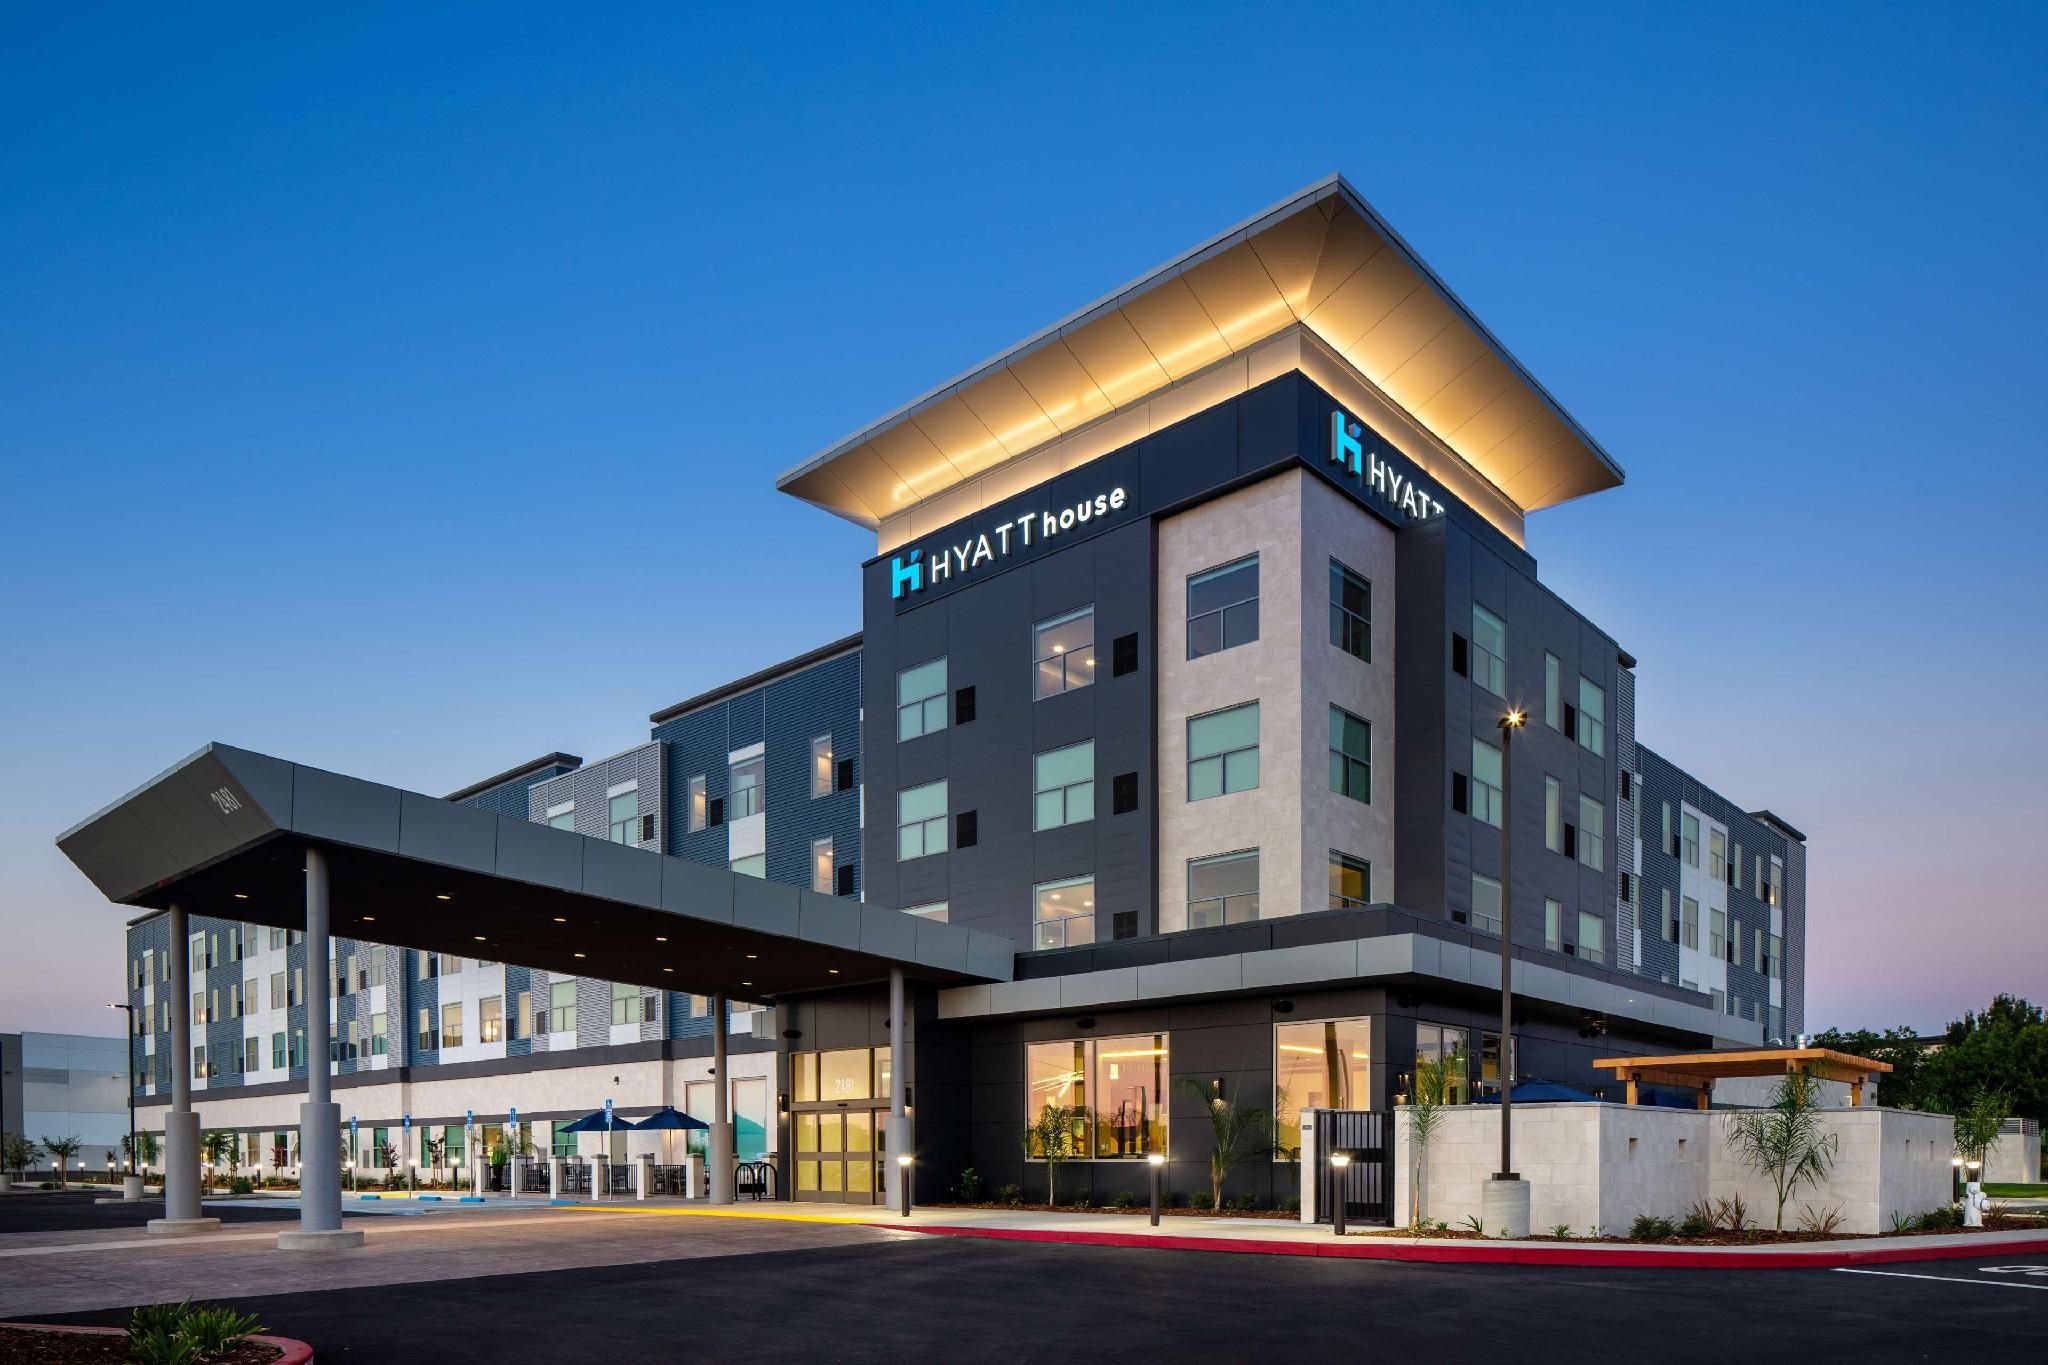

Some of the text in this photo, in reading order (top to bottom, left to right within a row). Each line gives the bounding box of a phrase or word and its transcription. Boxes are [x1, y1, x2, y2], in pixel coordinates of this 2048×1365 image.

[931, 512, 1038, 584] HYATT
[1043, 487, 1128, 538] house
[210, 786, 243, 815] 2481
[834, 1077, 855, 1094] 2481
